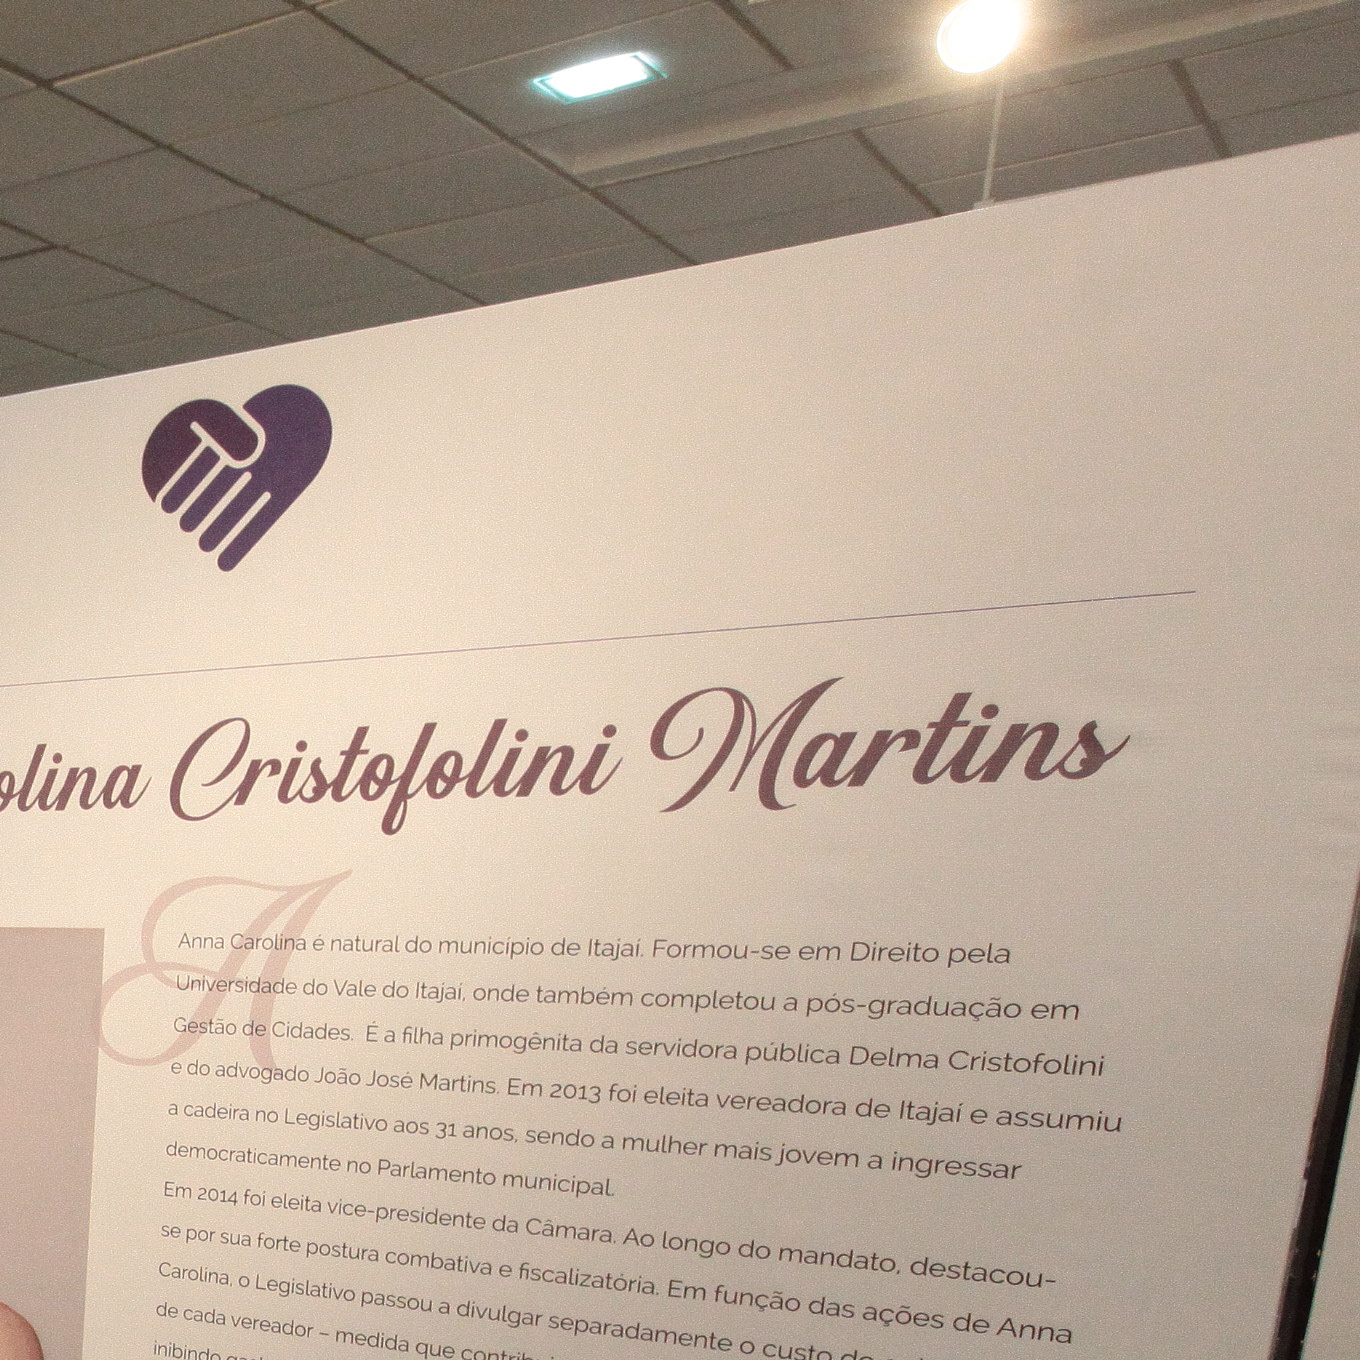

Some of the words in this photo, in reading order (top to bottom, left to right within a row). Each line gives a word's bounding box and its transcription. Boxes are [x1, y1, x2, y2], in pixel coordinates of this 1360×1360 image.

[169, 717, 622, 836] Cristofolini
[650, 677, 1131, 812] Martins
[99, 869, 353, 1068] A
[178, 932, 224, 948] Anna
[230, 933, 306, 951] Carolina
[312, 935, 324, 951] é
[330, 935, 399, 952] natural
[404, 935, 432, 953] do
[438, 939, 544, 959] município
[550, 937, 581, 956] de
[587, 938, 643, 961] Itajaí.
[652, 938, 791, 960] Formou-se
[798, 945, 841, 960] em
[849, 940, 939, 963] Direito
[946, 942, 1011, 968] pela
[163, 1180, 191, 1198] Em
[197, 1187, 237, 1205] 2014
[243, 1188, 265, 1206] foi
[270, 1193, 321, 1212] eleita
[327, 1201, 486, 1229] vice-presidente
[491, 1214, 518, 1233] da
[525, 1217, 616, 1243] Câmara.
[622, 1227, 655, 1247] Ao
[661, 1230, 731, 1259] longo
[737, 1239, 771, 1259] do
[778, 1246, 900, 1274] mandato,
[909, 1256, 1056, 1288] destacou-
